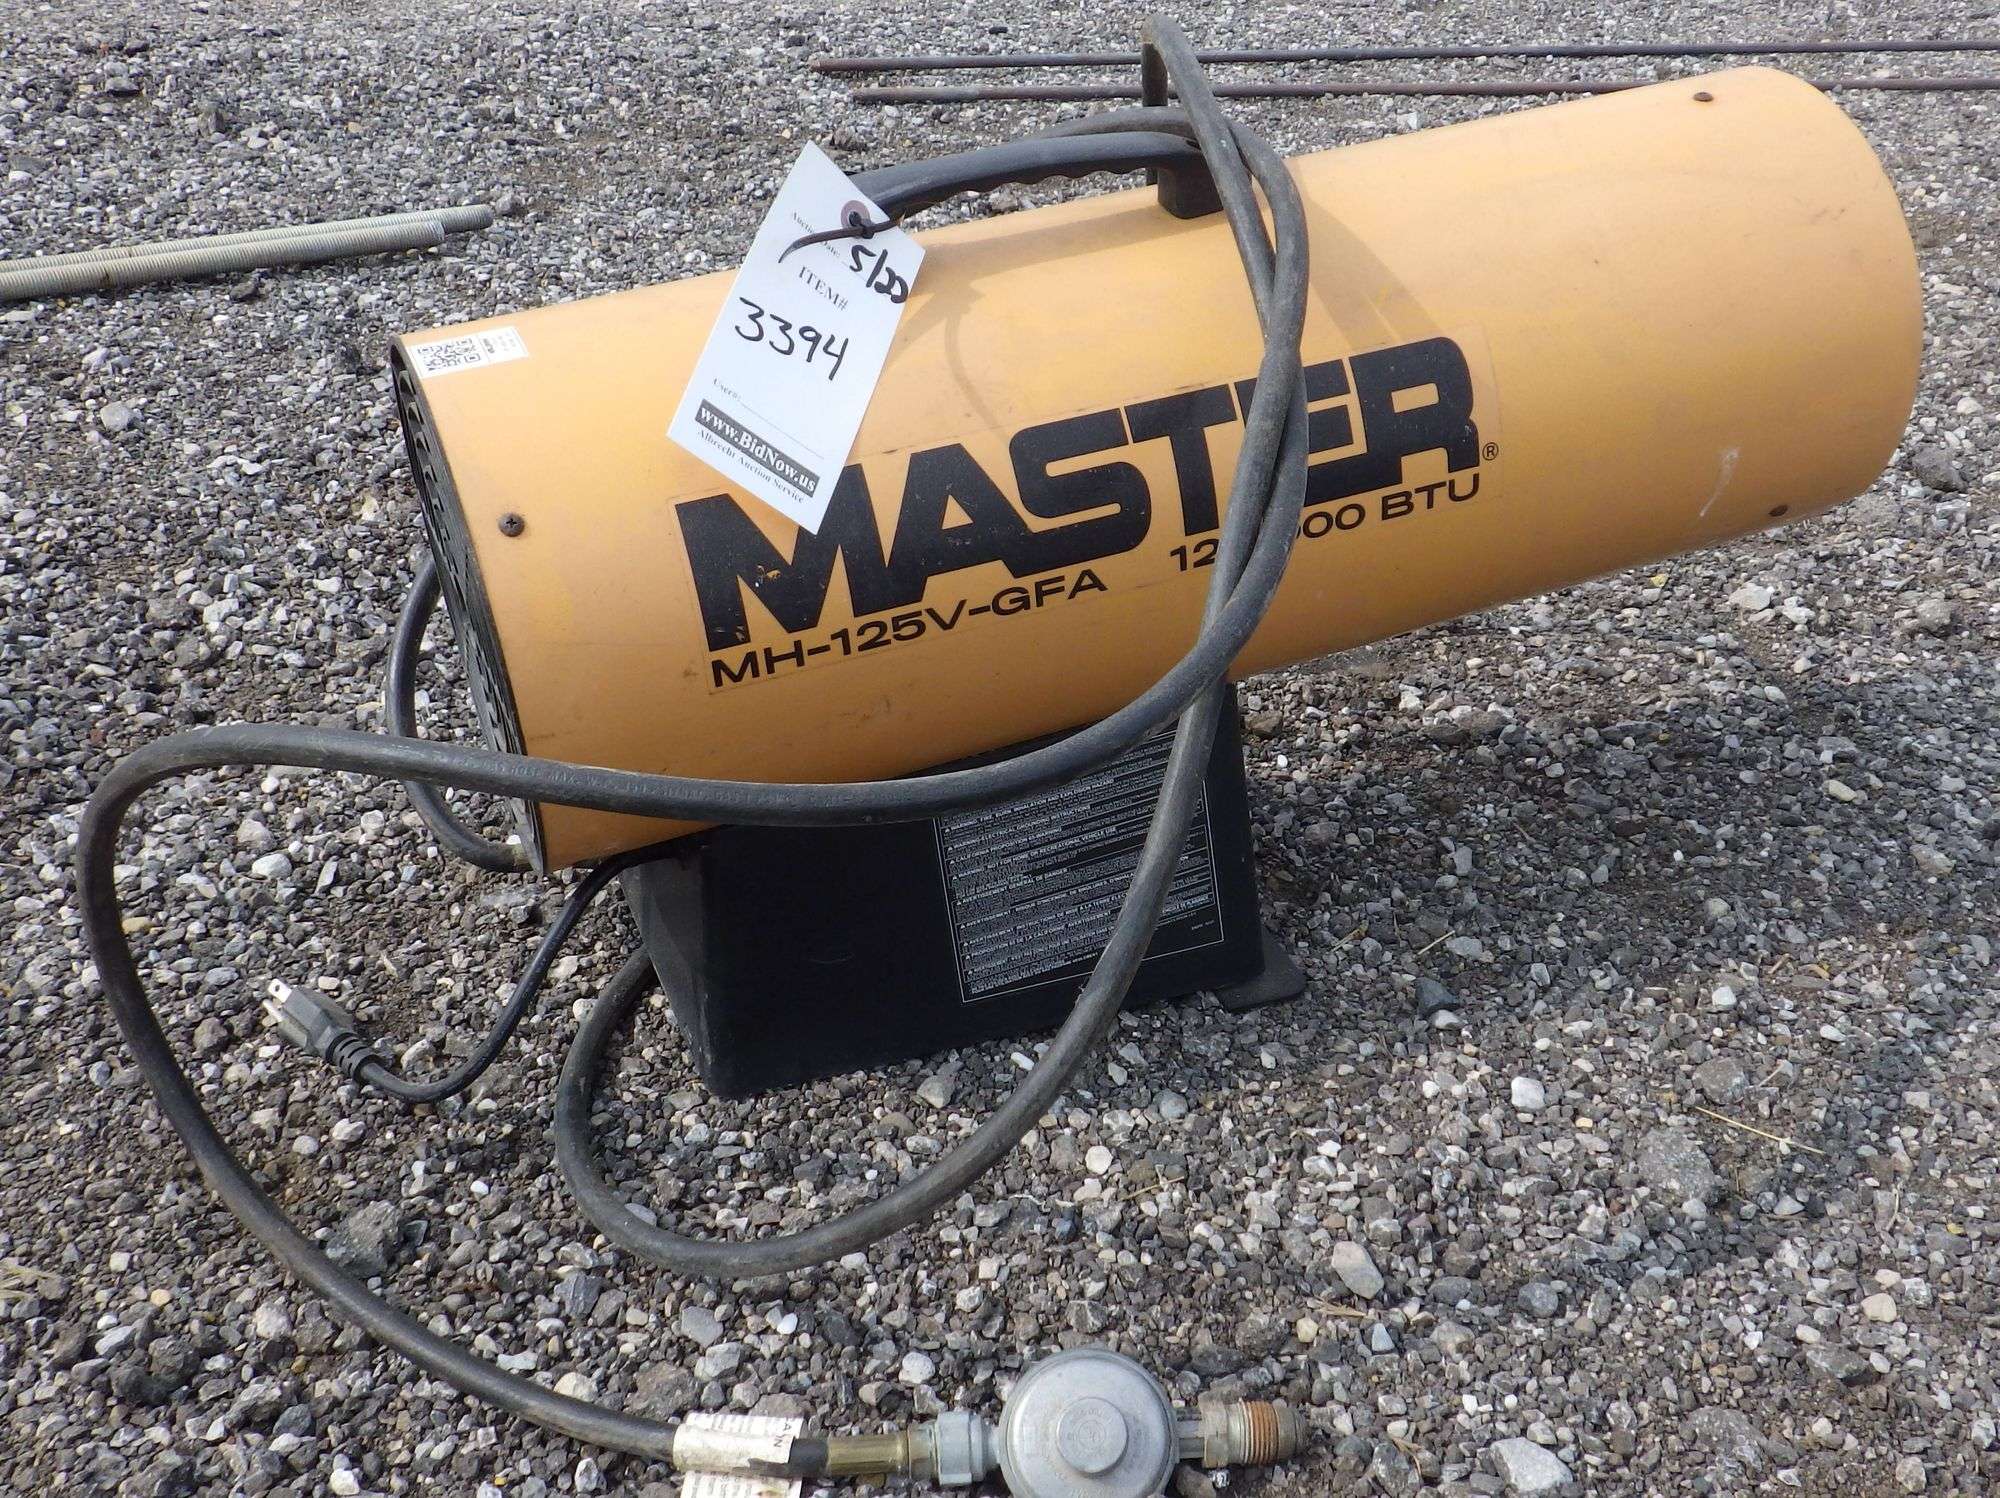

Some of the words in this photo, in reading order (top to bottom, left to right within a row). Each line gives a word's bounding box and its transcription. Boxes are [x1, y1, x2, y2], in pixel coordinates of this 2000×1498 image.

[798, 266, 849, 311] ITEM#
[734, 297, 849, 381] 3394
[698, 430, 736, 459] Albrecht
[736, 456, 772, 481] Auction
[773, 478, 806, 503] Service
[699, 406, 817, 493] www.BidNow.us
[675, 337, 1480, 652] MASTER
[1170, 503, 1366, 572] 1200
[1381, 473, 1480, 521] BTU
[710, 568, 1109, 688] MH-125V-GFA
